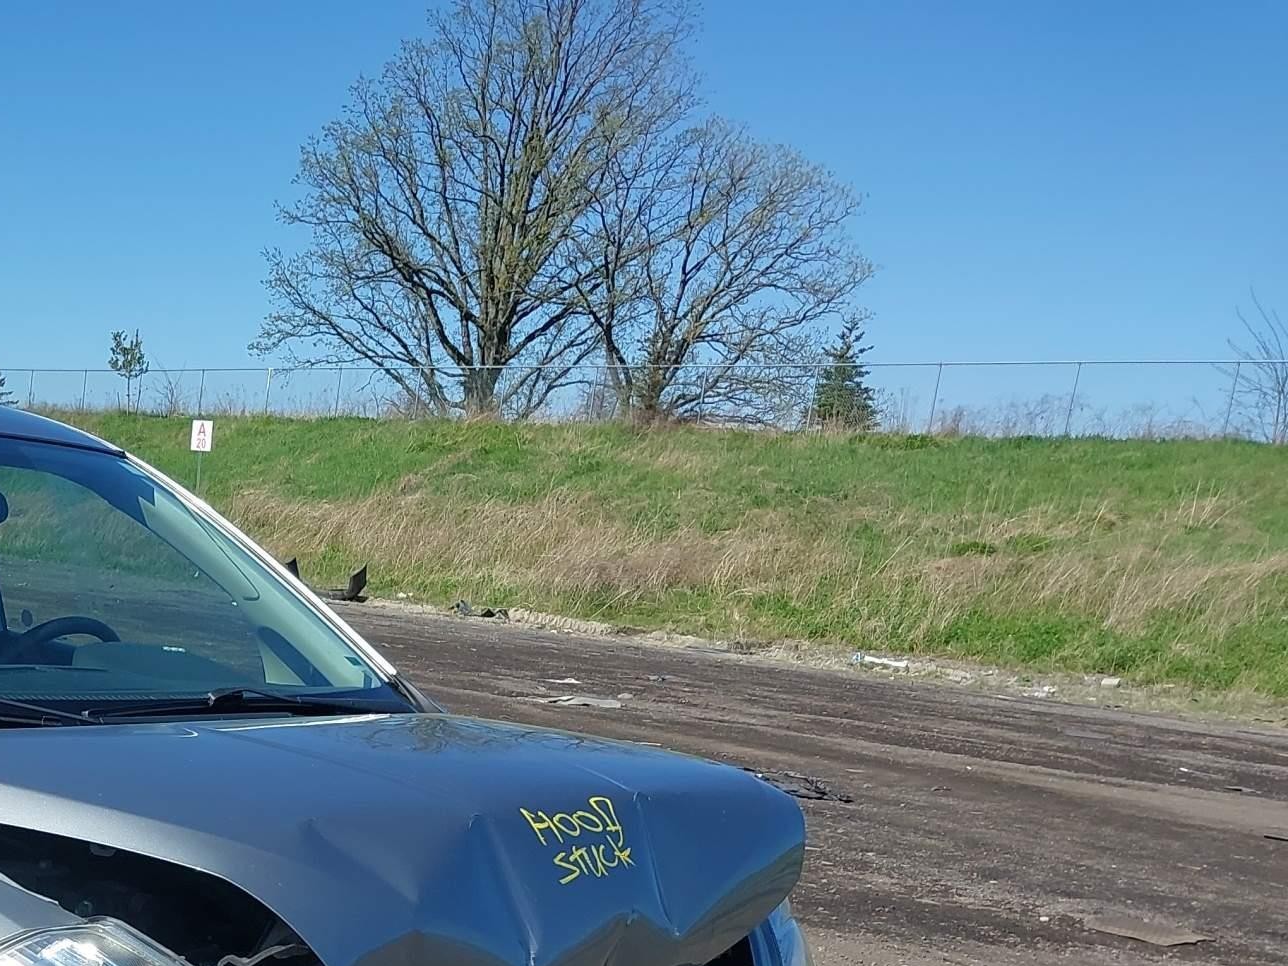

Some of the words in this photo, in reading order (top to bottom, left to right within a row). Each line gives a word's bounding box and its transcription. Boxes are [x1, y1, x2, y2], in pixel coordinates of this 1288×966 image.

[196, 438, 206, 449] 20
[197, 422, 206, 437] A
[520, 796, 624, 847] HOOD
[553, 834, 637, 885] STUCK
